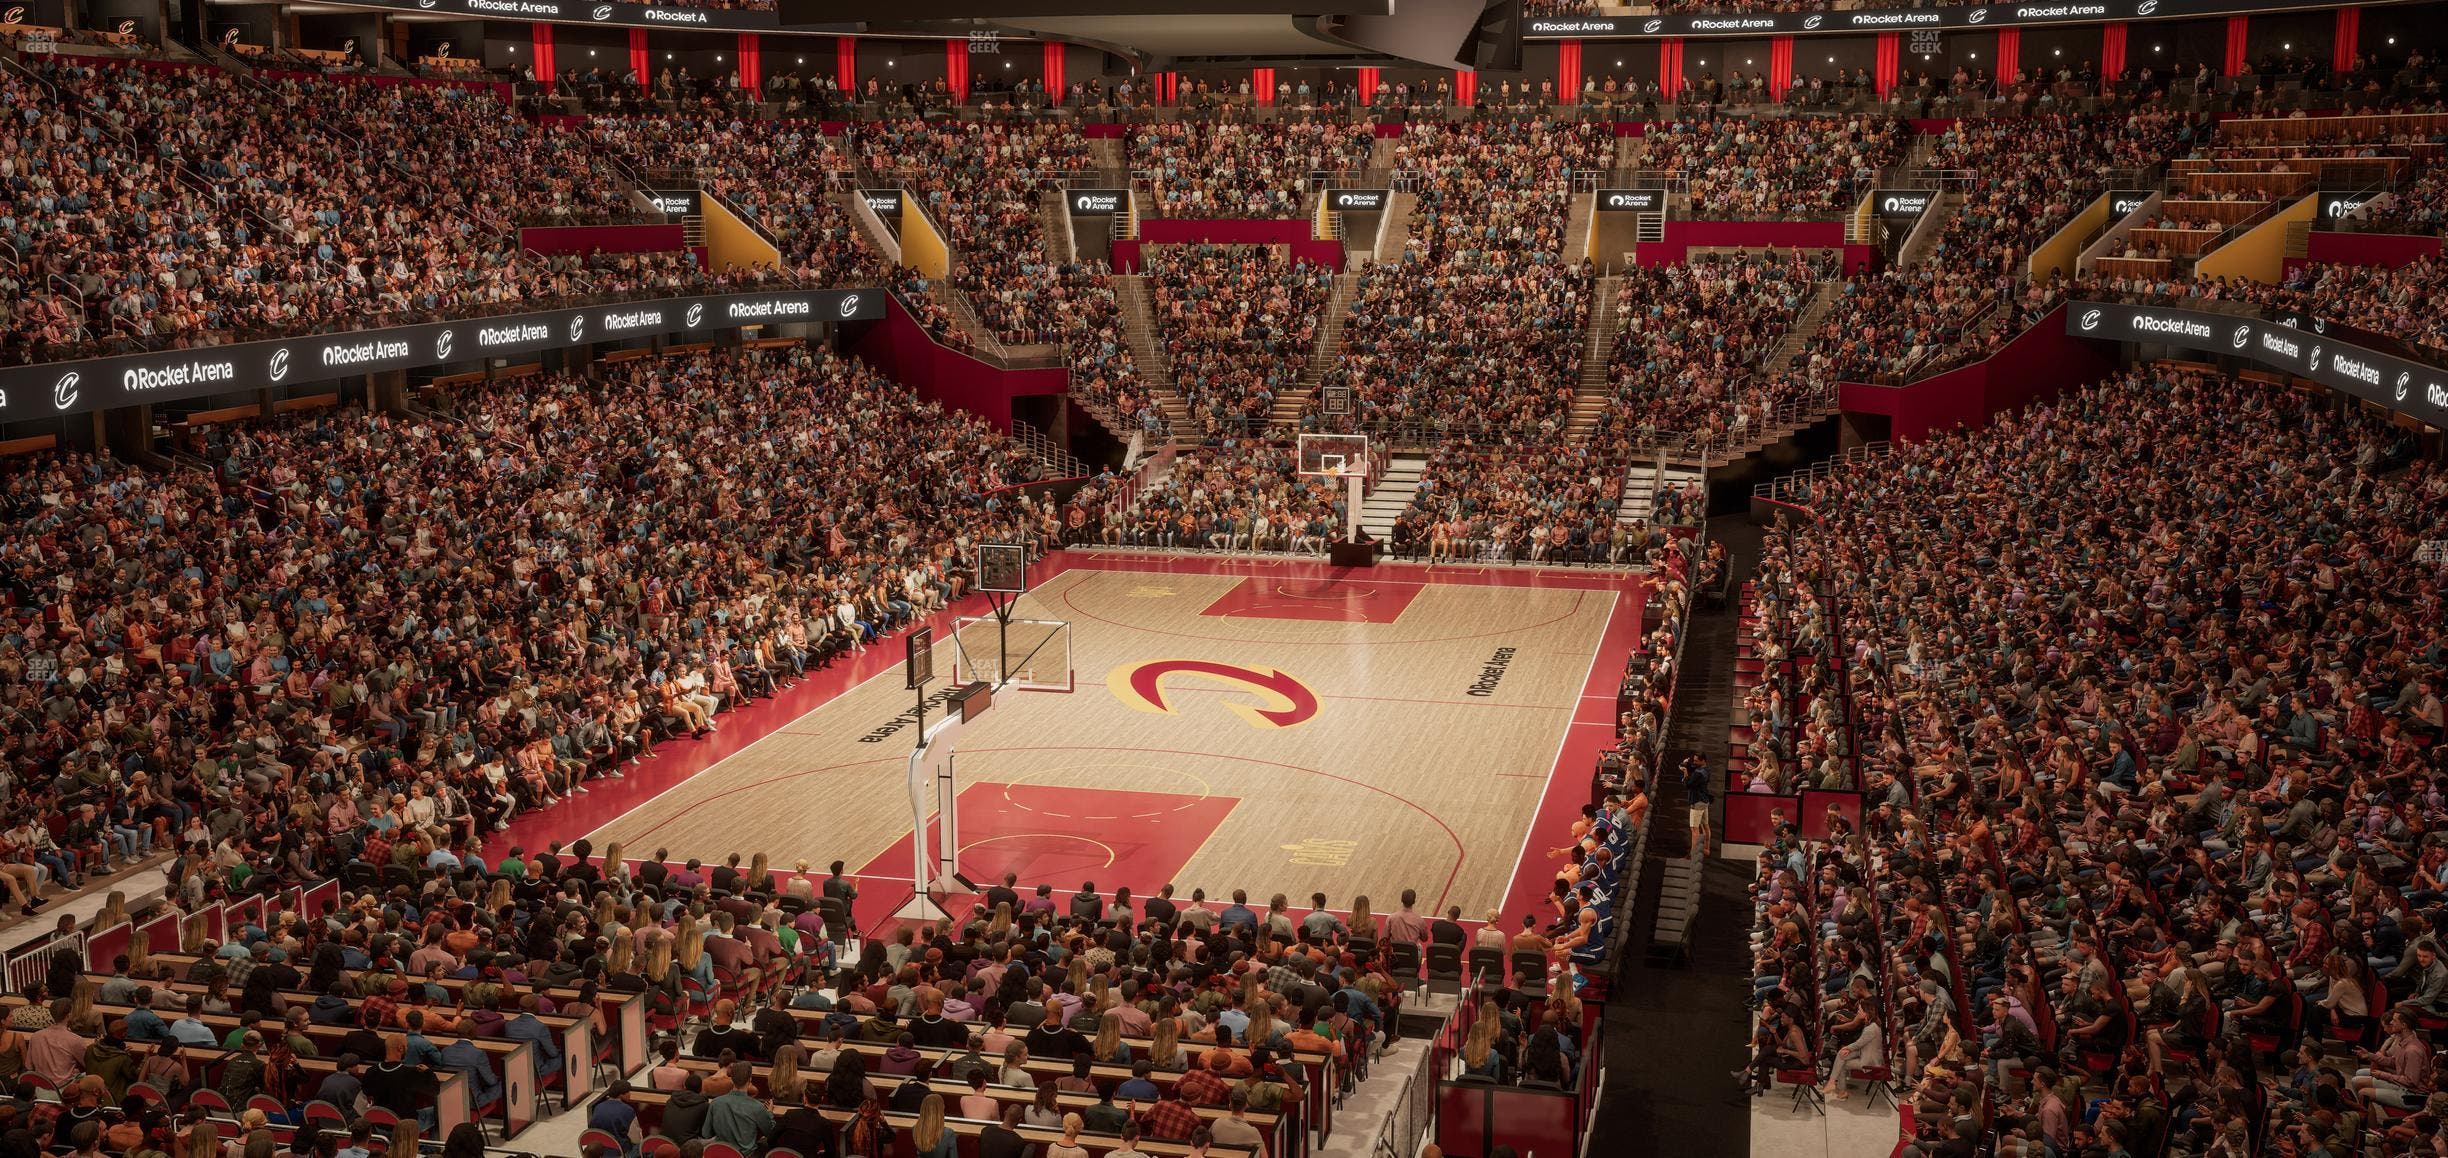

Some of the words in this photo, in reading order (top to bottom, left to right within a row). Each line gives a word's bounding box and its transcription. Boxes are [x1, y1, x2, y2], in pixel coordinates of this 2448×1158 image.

[479, 0, 519, 12] Rocket
[520, 2, 559, 14] Arena
[656, 9, 697, 22] Rocket
[2028, 6, 2069, 17] Rocket
[2069, 5, 2105, 15] Arena
[1543, 22, 1581, 31] Rocket
[1582, 21, 1614, 30] Arena
[1703, 19, 1740, 29] Rocket
[1741, 18, 1774, 28] Arena
[1864, 14, 1903, 24] Rocket
[1904, 13, 1940, 23] Arena
[738, 301, 773, 318] Rocket
[774, 300, 809, 315] Arena
[612, 312, 639, 330] Rocket
[639, 310, 662, 327] Arena
[2145, 315, 2184, 334] Rocket
[2184, 320, 2211, 338] Arena
[488, 325, 521, 346] Rocket
[521, 323, 548, 342] Arena
[333, 343, 375, 366] Rocket
[376, 340, 409, 360] Arena
[2267, 334, 2284, 354] Rocket
[2284, 338, 2299, 359] Arena
[138, 364, 190, 390] Rocket
[192, 361, 234, 385] Arena
[2339, 356, 2361, 379] Rocket
[2361, 362, 2380, 385] Arena
[1484, 647, 1517, 667] Arena
[1469, 666, 1507, 690] Rocket
[858, 717, 917, 743] Arena
